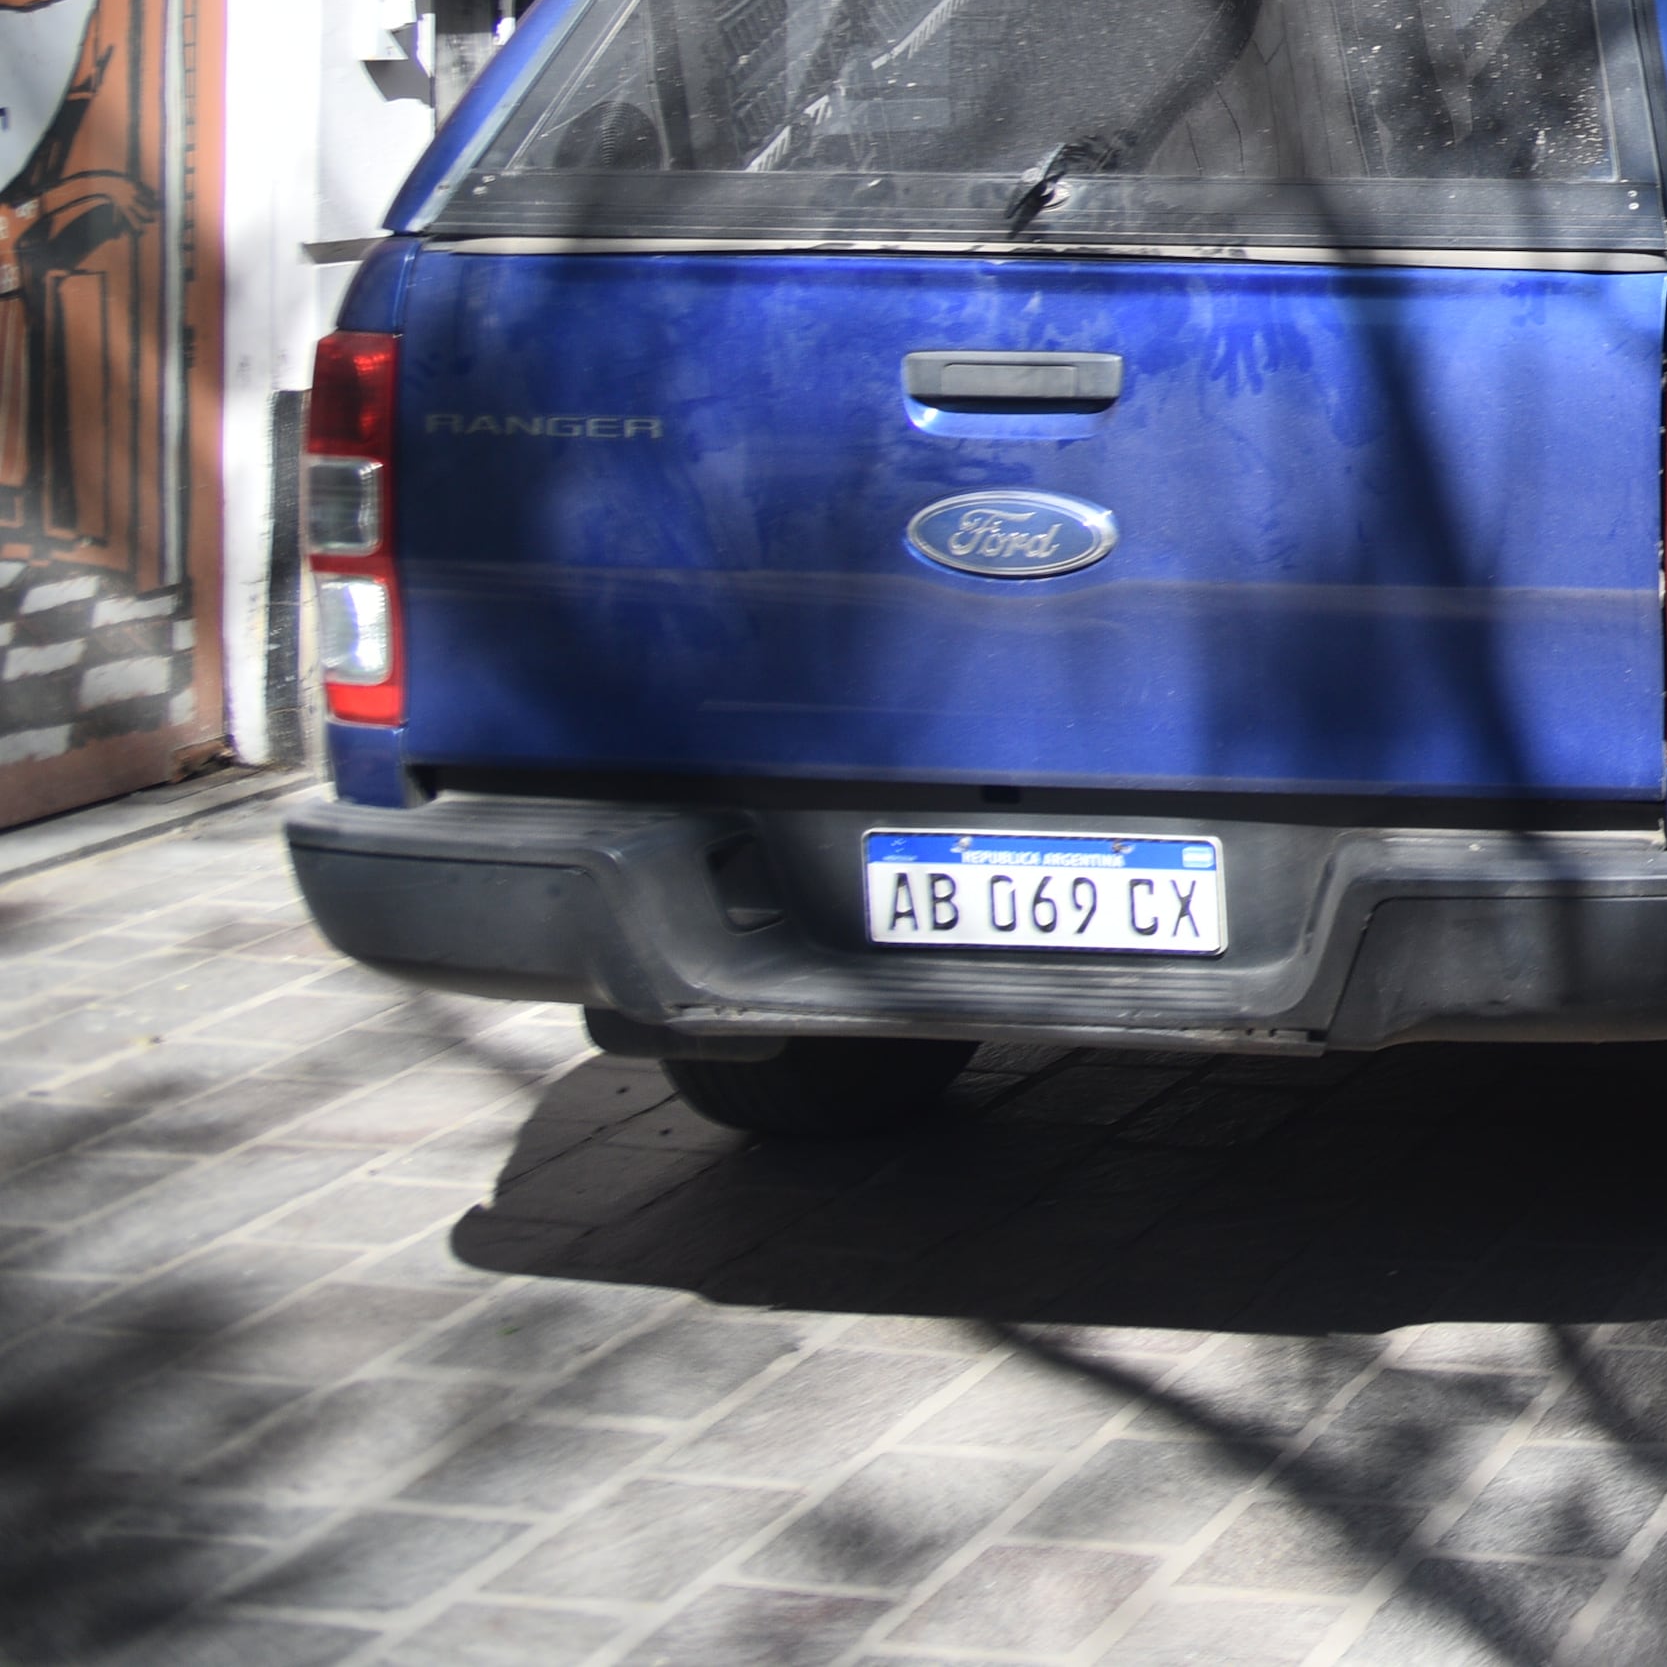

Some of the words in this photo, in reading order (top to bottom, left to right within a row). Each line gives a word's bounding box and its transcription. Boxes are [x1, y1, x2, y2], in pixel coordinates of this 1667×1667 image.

[425, 413, 664, 438] RANGER
[948, 508, 1063, 558] Ford
[1042, 852, 1126, 868] ARGENTINA
[889, 872, 960, 932] AB
[990, 874, 1097, 935] 069
[1129, 878, 1199, 938] CX
